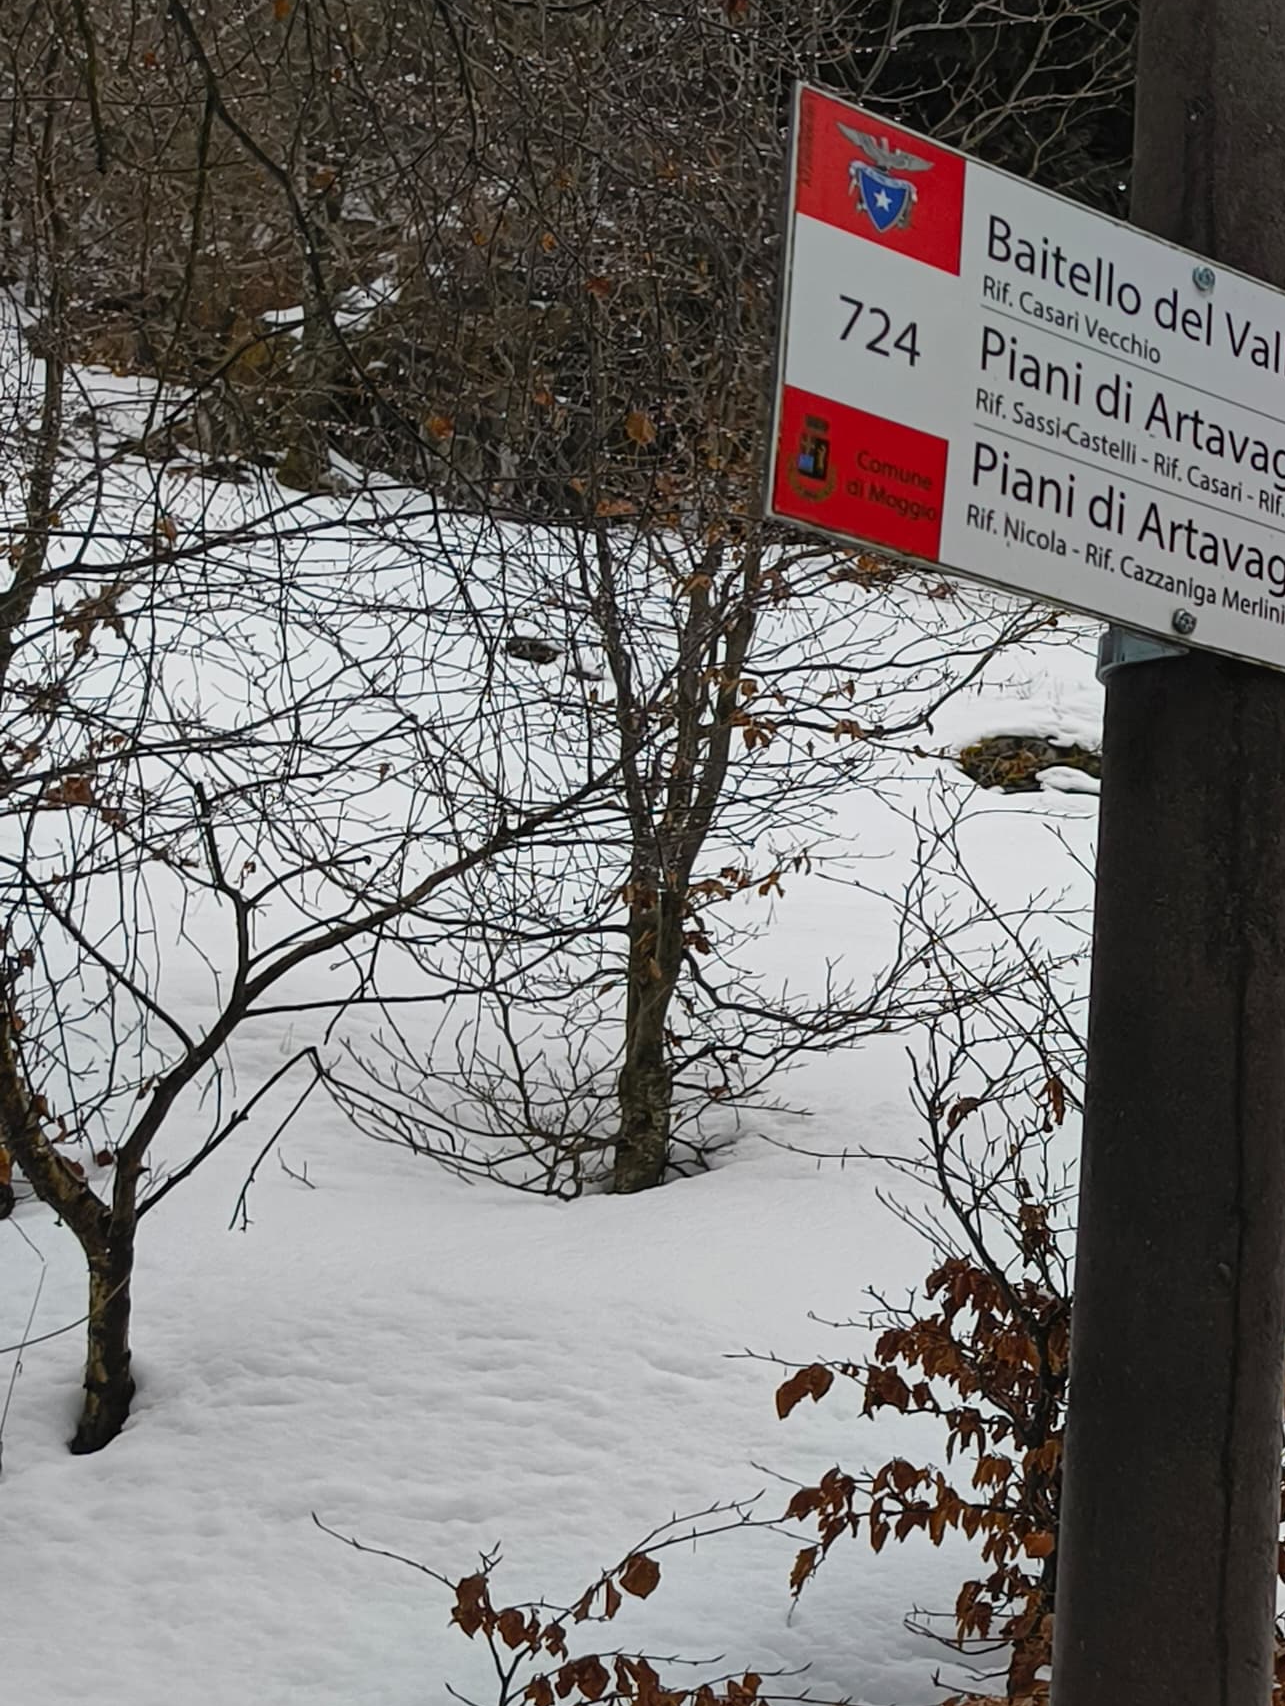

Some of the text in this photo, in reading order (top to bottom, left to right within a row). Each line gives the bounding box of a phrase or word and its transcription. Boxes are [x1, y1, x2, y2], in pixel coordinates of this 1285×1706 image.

[982, 274, 1161, 365] Rif. Casari Vecchio
[987, 213, 1142, 316] Baitello
[1154, 287, 1213, 347] del
[839, 293, 921, 368] 724
[980, 325, 1083, 406] Piani
[1095, 373, 1133, 425] di
[856, 450, 933, 492] Comune
[972, 441, 1076, 519] Piani
[1088, 484, 1127, 536] di
[975, 387, 1007, 420] Rif.
[1011, 401, 1137, 466] Sassi-Castelli
[1153, 451, 1183, 483] Rif.
[1186, 465, 1243, 503] Casari
[847, 478, 936, 522] di Moggio
[966, 503, 998, 535] Rif.
[1003, 512, 1067, 558] Nicola
[1084, 542, 1115, 574] Rif.
[1119, 555, 1217, 608] Cazzaniga
[1221, 586, 1285, 626] Merlini
